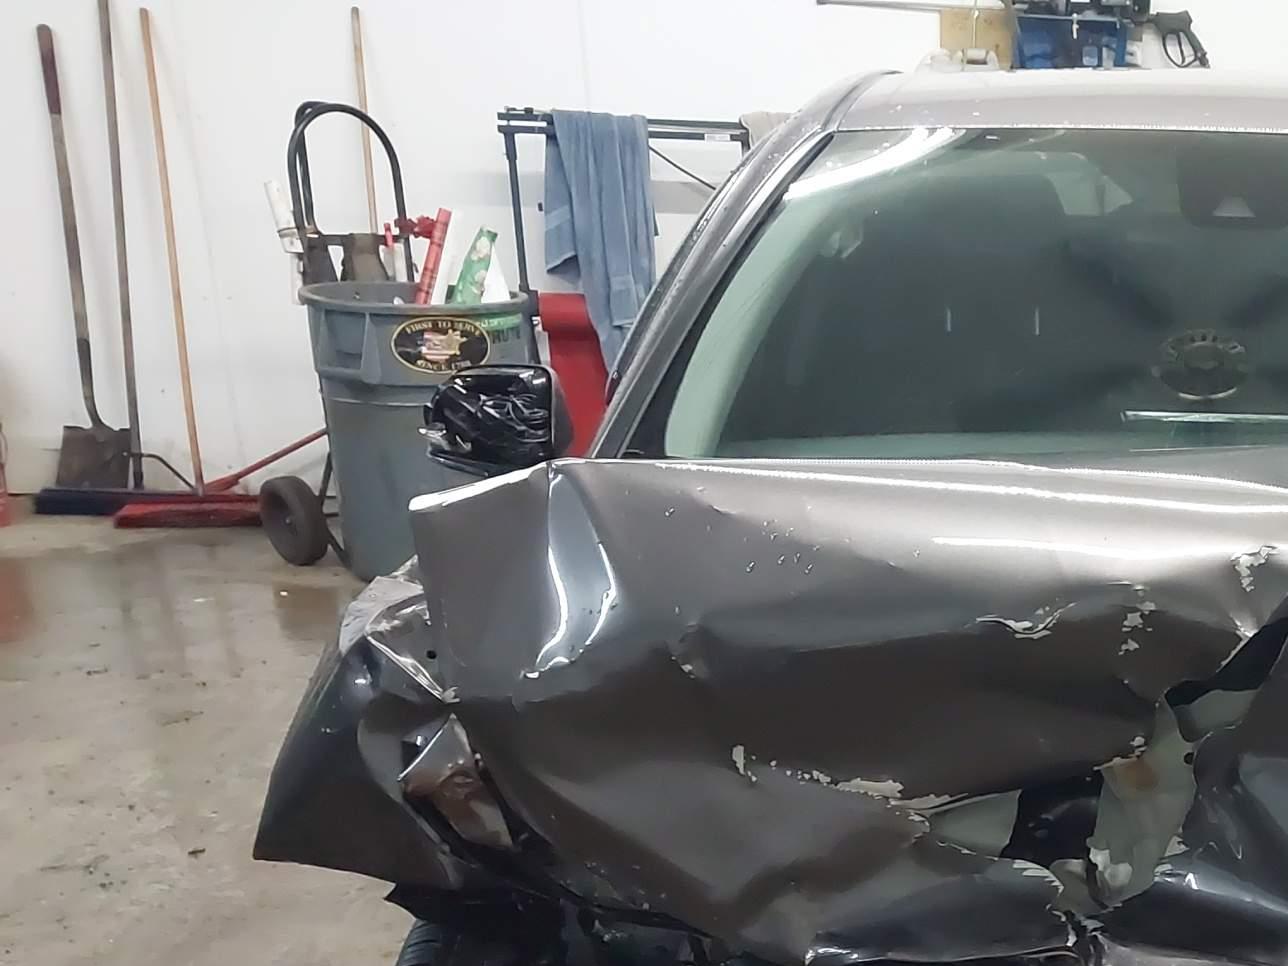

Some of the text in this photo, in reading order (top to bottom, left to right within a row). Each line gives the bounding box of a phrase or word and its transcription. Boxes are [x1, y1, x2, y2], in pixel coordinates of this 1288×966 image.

[405, 320, 433, 335] FIRST
[437, 320, 451, 328] TO
[416, 359, 450, 370] SINCE
